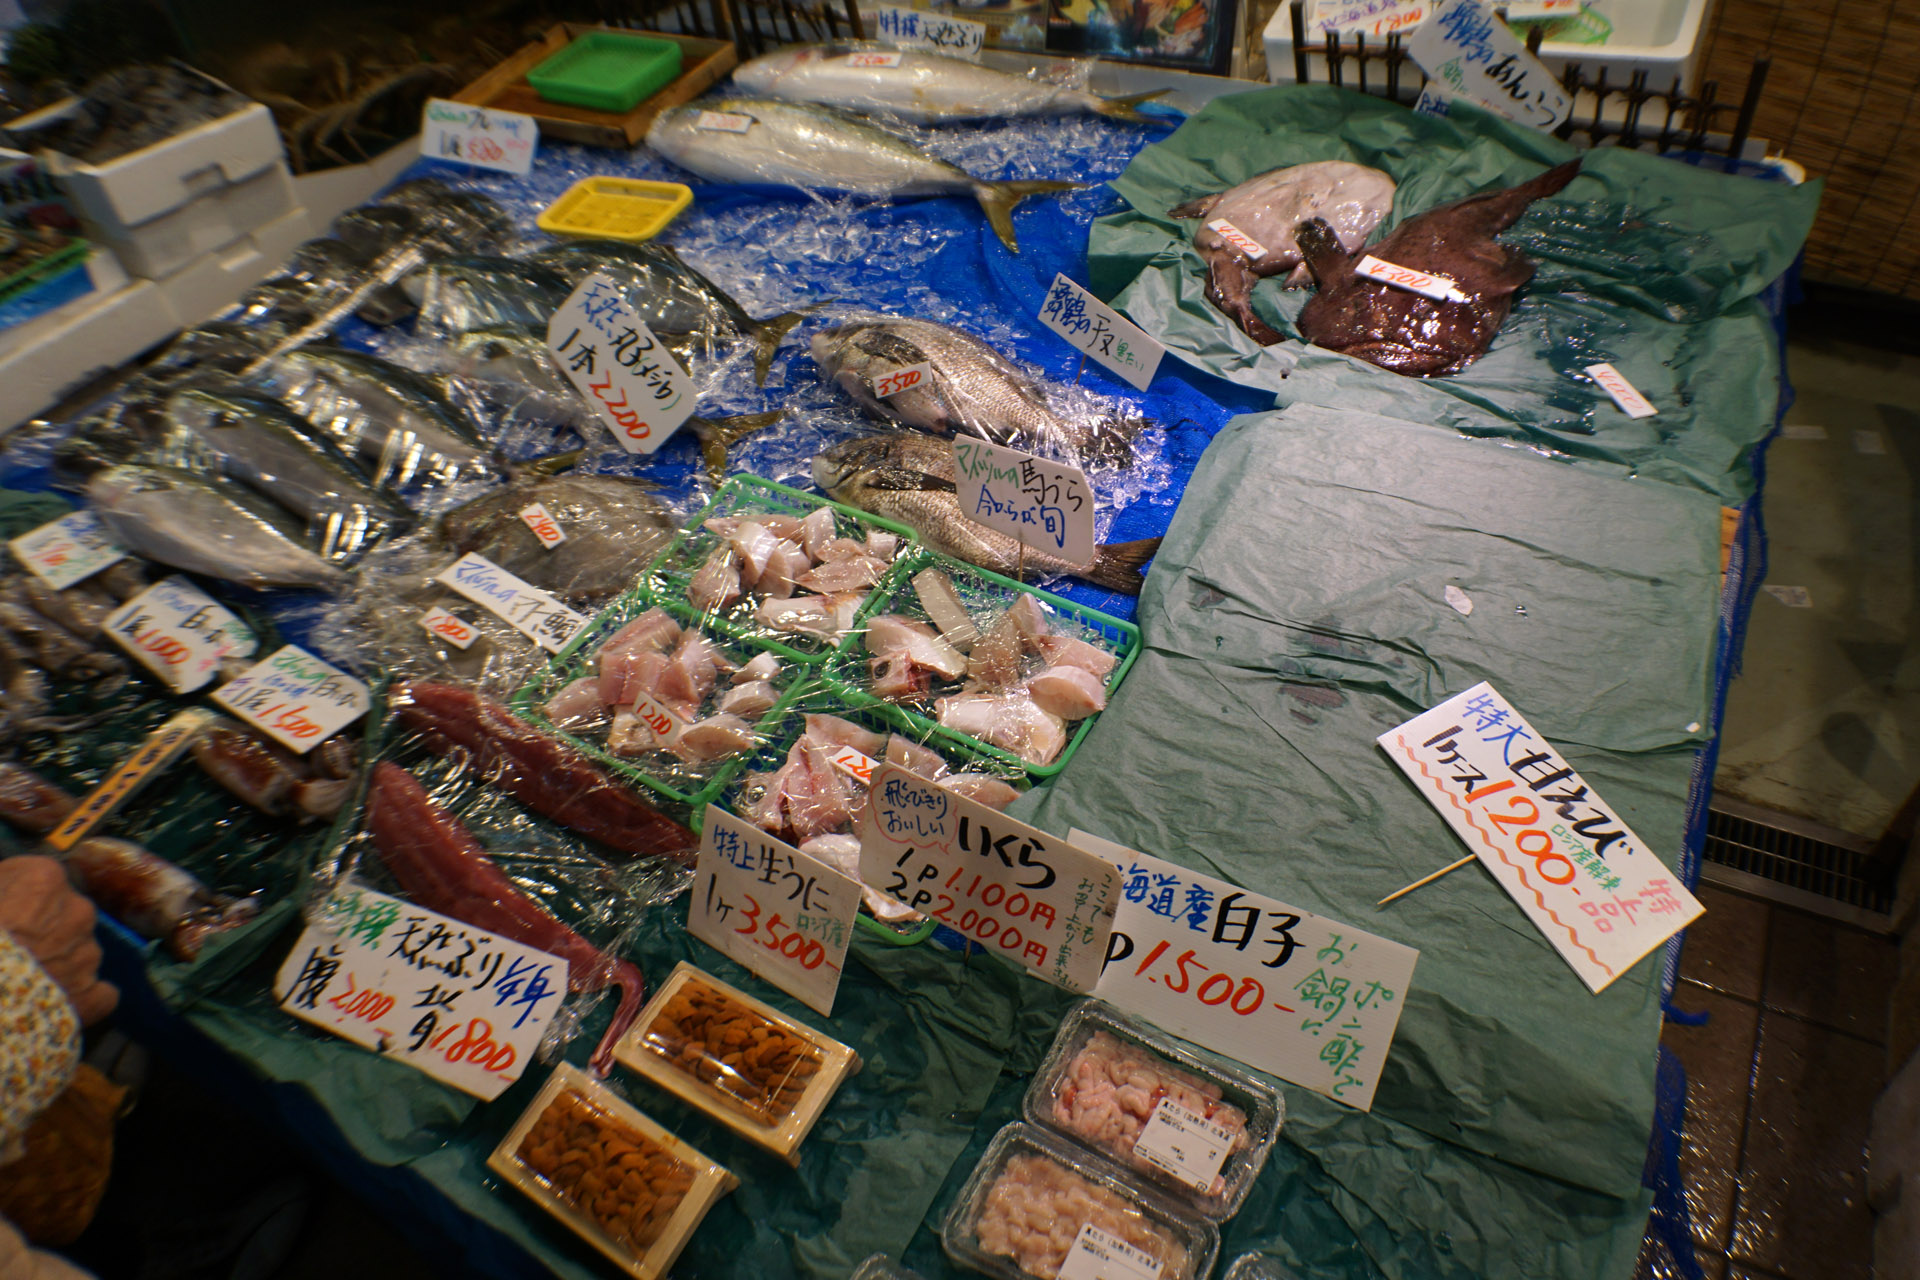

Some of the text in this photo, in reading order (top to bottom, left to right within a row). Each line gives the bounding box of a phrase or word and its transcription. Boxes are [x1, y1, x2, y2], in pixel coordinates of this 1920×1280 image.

[1485, 52, 1557, 126] あんこう
[1369, 263, 1433, 289] 4300
[878, 370, 922, 395] 3500
[635, 701, 673, 736] 1200
[1461, 692, 1634, 861] 特大 甘えび
[882, 810, 945, 837] おいしい
[713, 824, 830, 912] 特上 生うに
[958, 815, 1057, 890] いくら
[796, 911, 848, 949] ロシア産
[1115, 862, 1308, 969] 海道産 白子
